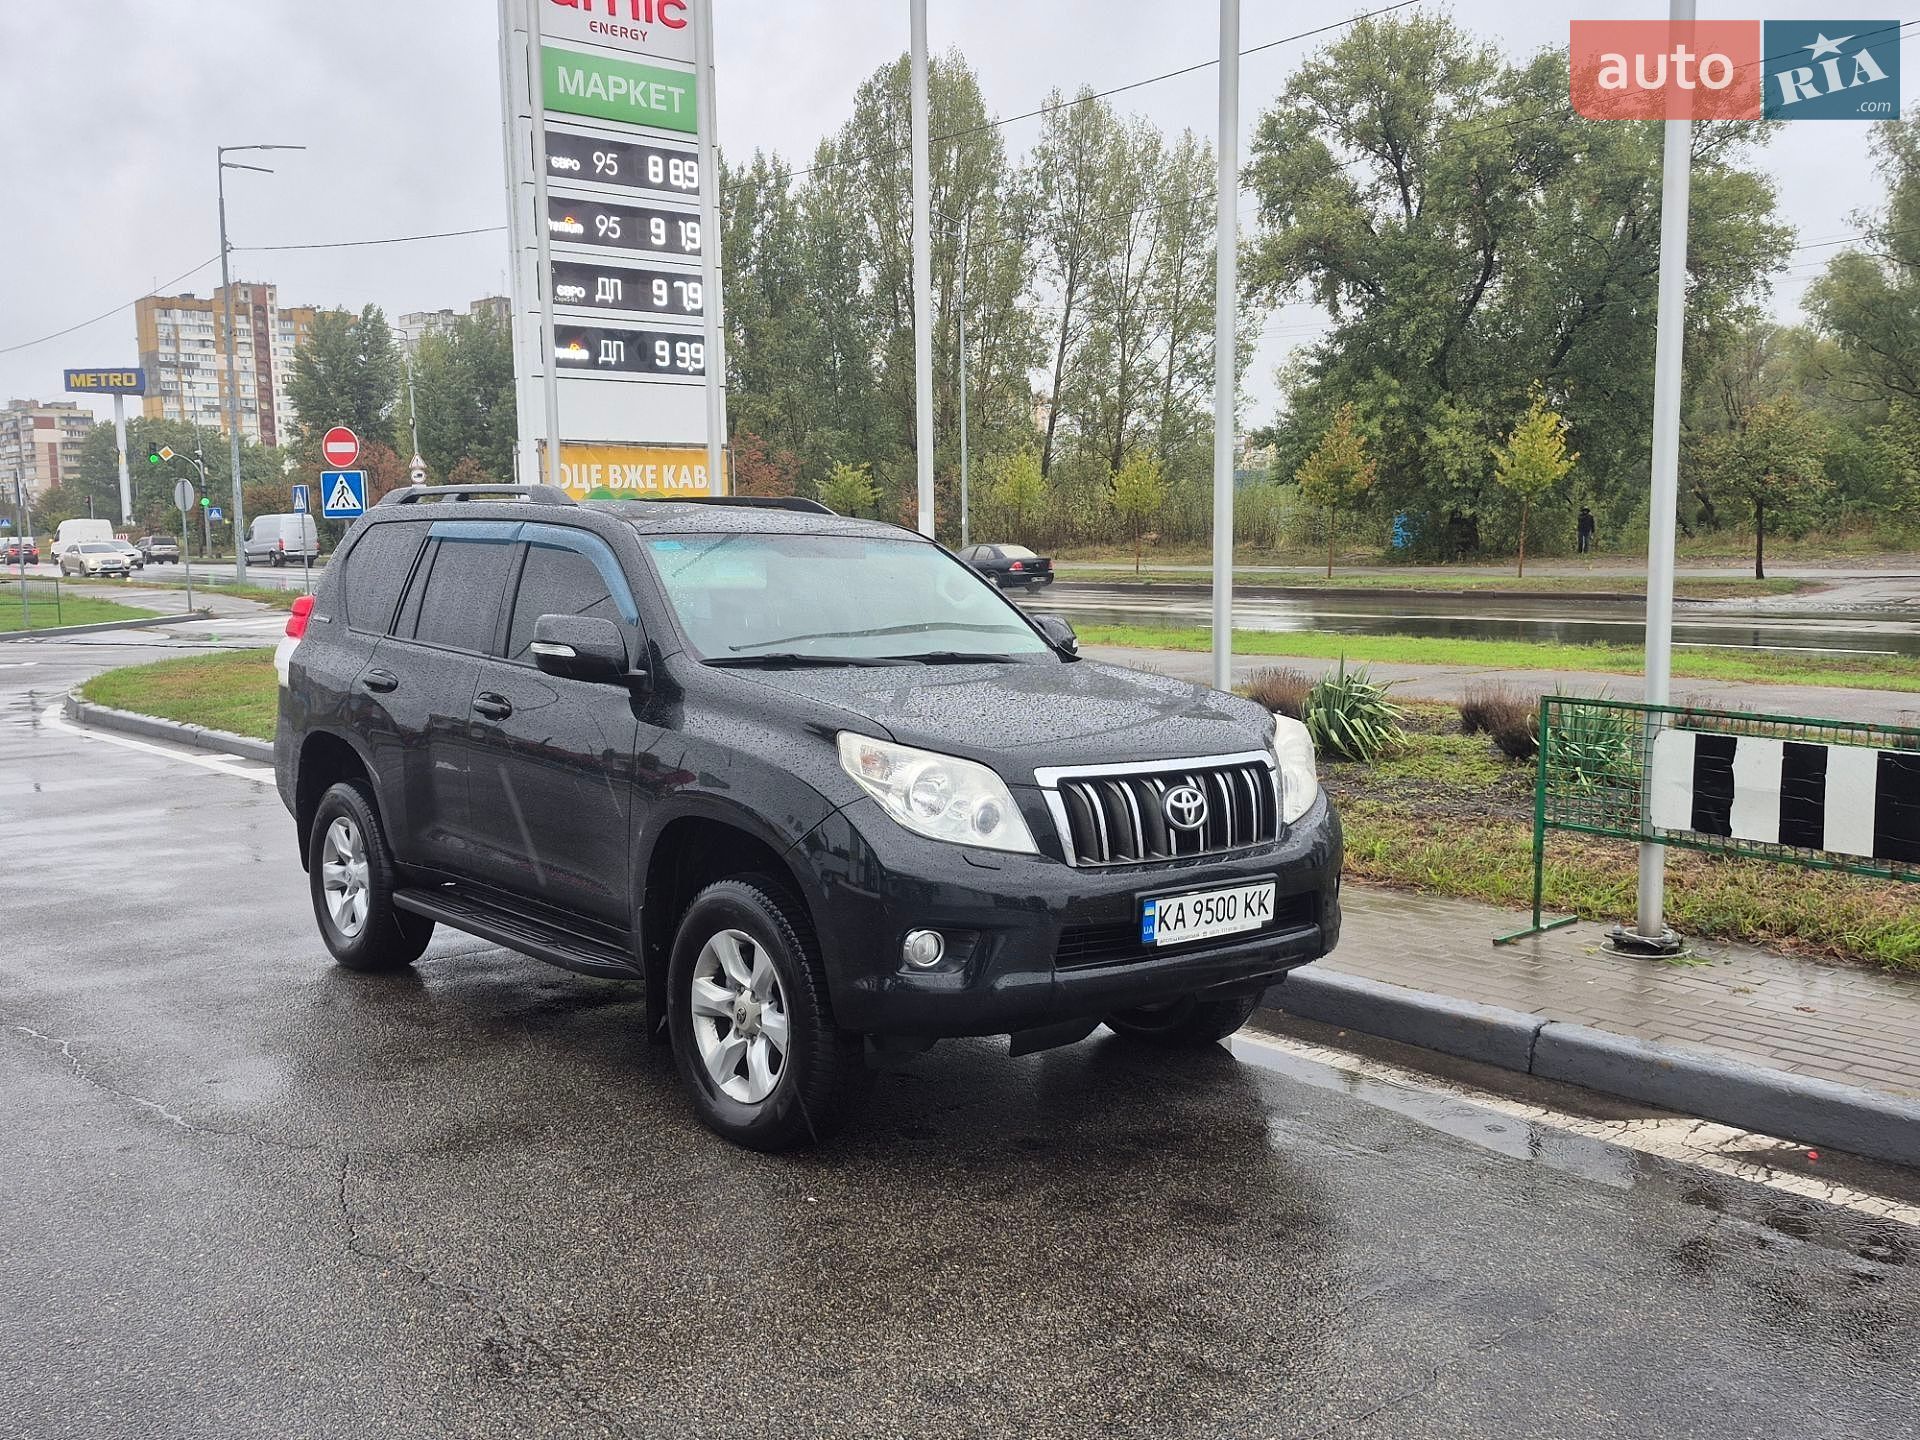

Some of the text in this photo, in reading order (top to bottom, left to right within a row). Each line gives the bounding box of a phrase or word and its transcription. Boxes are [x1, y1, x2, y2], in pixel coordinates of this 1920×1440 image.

[589, 20, 648, 42] ENERGY
[557, 66, 685, 113] МАРКЕТ
[592, 151, 618, 176] 95
[595, 214, 621, 239] 95
[595, 277, 622, 303] ДП
[598, 340, 625, 365] ДП
[69, 372, 137, 388] METRO
[608, 464, 657, 489] ВЖЕ
[662, 464, 711, 489] КАВ
[1158, 902, 1187, 932] KA
[1193, 894, 1237, 928] 9500
[1244, 888, 1271, 919] KK
[1143, 926, 1154, 935] UA
